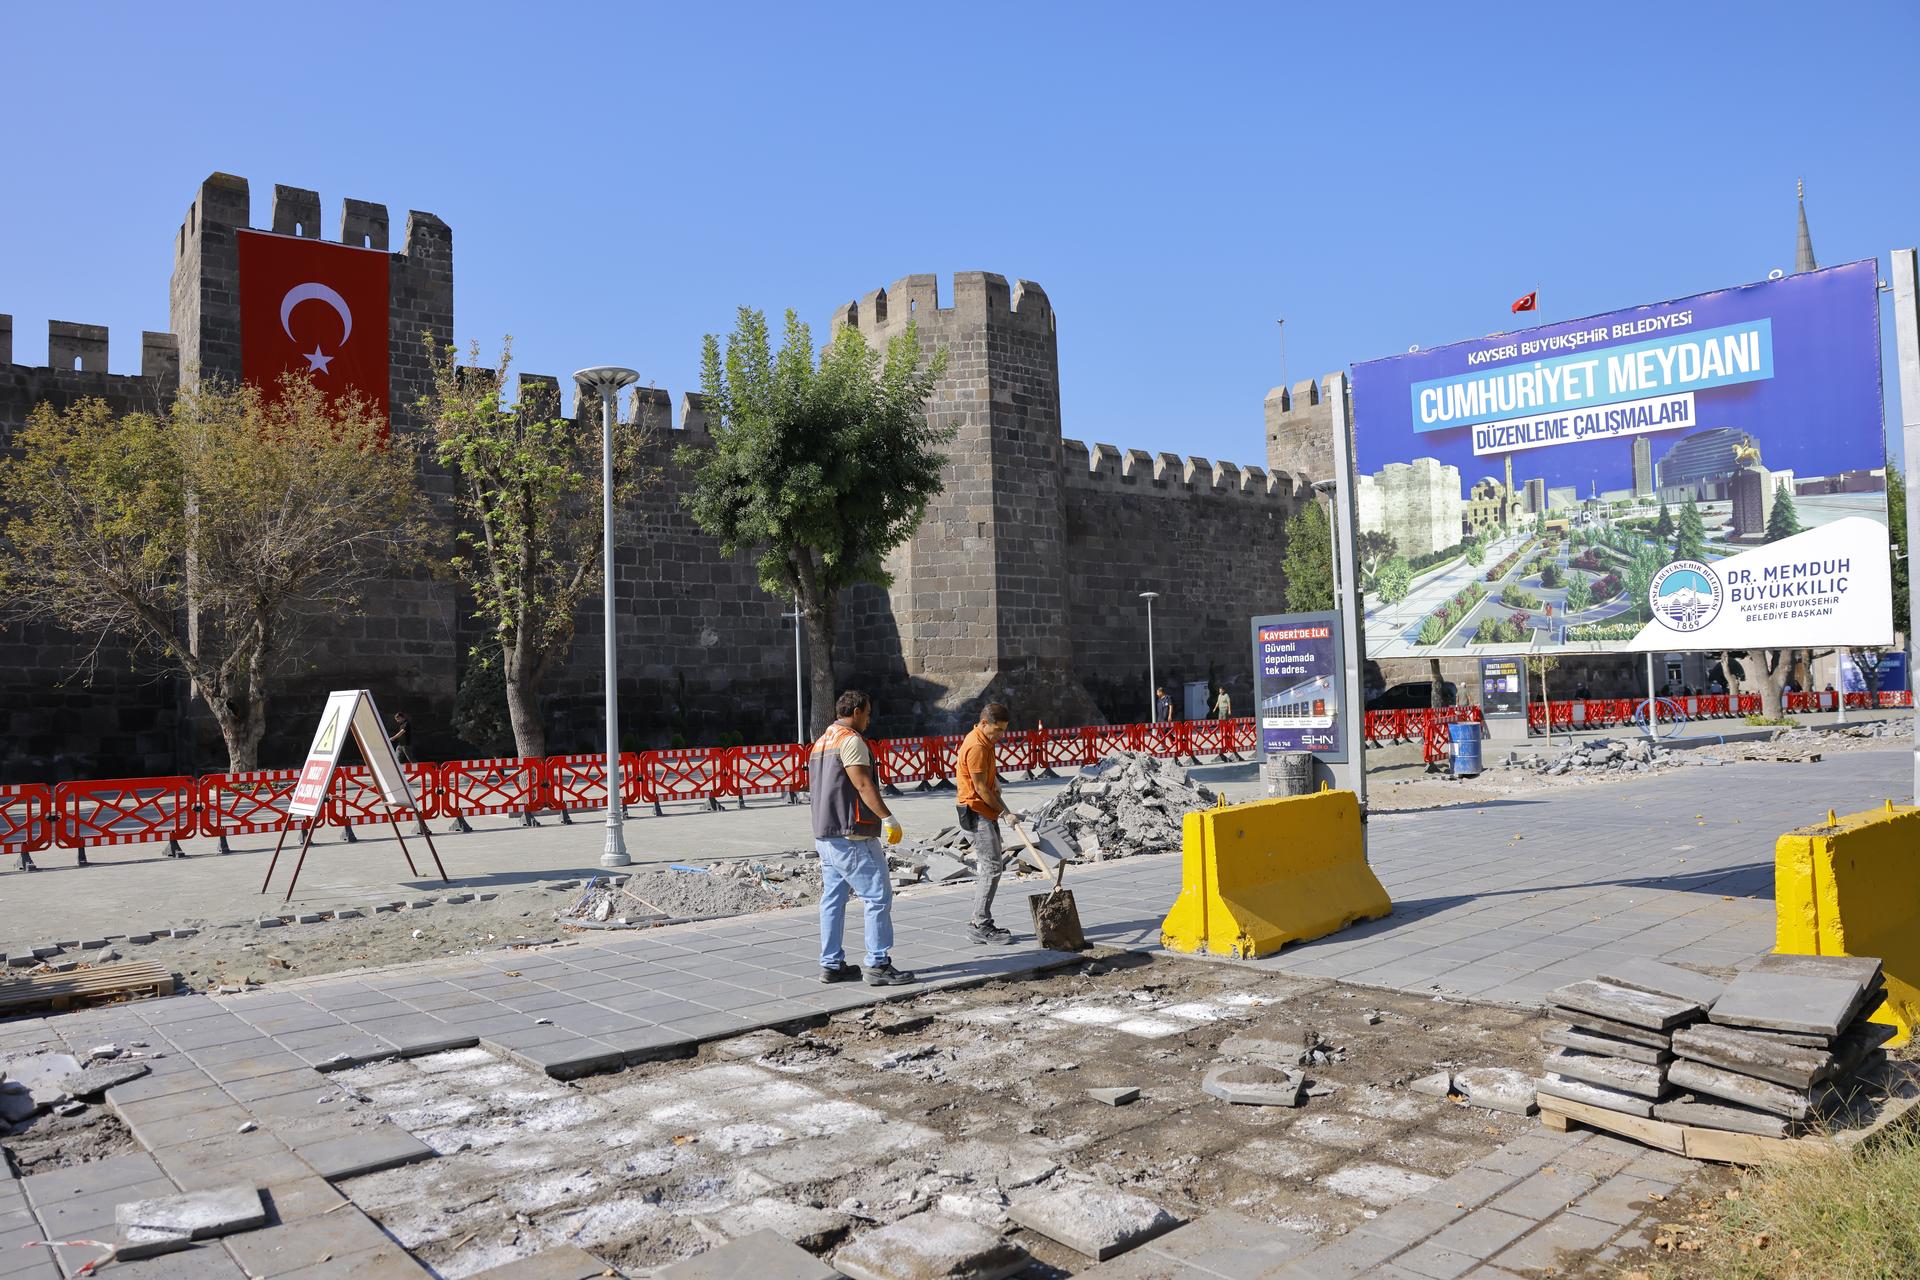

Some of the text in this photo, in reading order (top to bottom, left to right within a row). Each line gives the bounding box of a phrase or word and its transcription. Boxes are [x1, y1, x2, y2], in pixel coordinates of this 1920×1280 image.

[1420, 331, 1761, 424] CUMHURİYET MEYDANI
[1476, 400, 1689, 450] DÜZENLEME ÇALIŞMALARI
[1728, 558, 1850, 585] DR. MEMDUH
[1731, 577, 1848, 602] BÜYÜKKILIÇ
[1791, 608, 1833, 619] BAŞKANI
[1676, 620, 1699, 630] 1869
[1264, 627, 1328, 640] KAYSERİ'DE İLK!
[1265, 642, 1295, 653] Güvenli
[1265, 653, 1315, 665] depolamada
[1265, 665, 1308, 675] tek adres.
[1301, 735, 1334, 744] SHN
